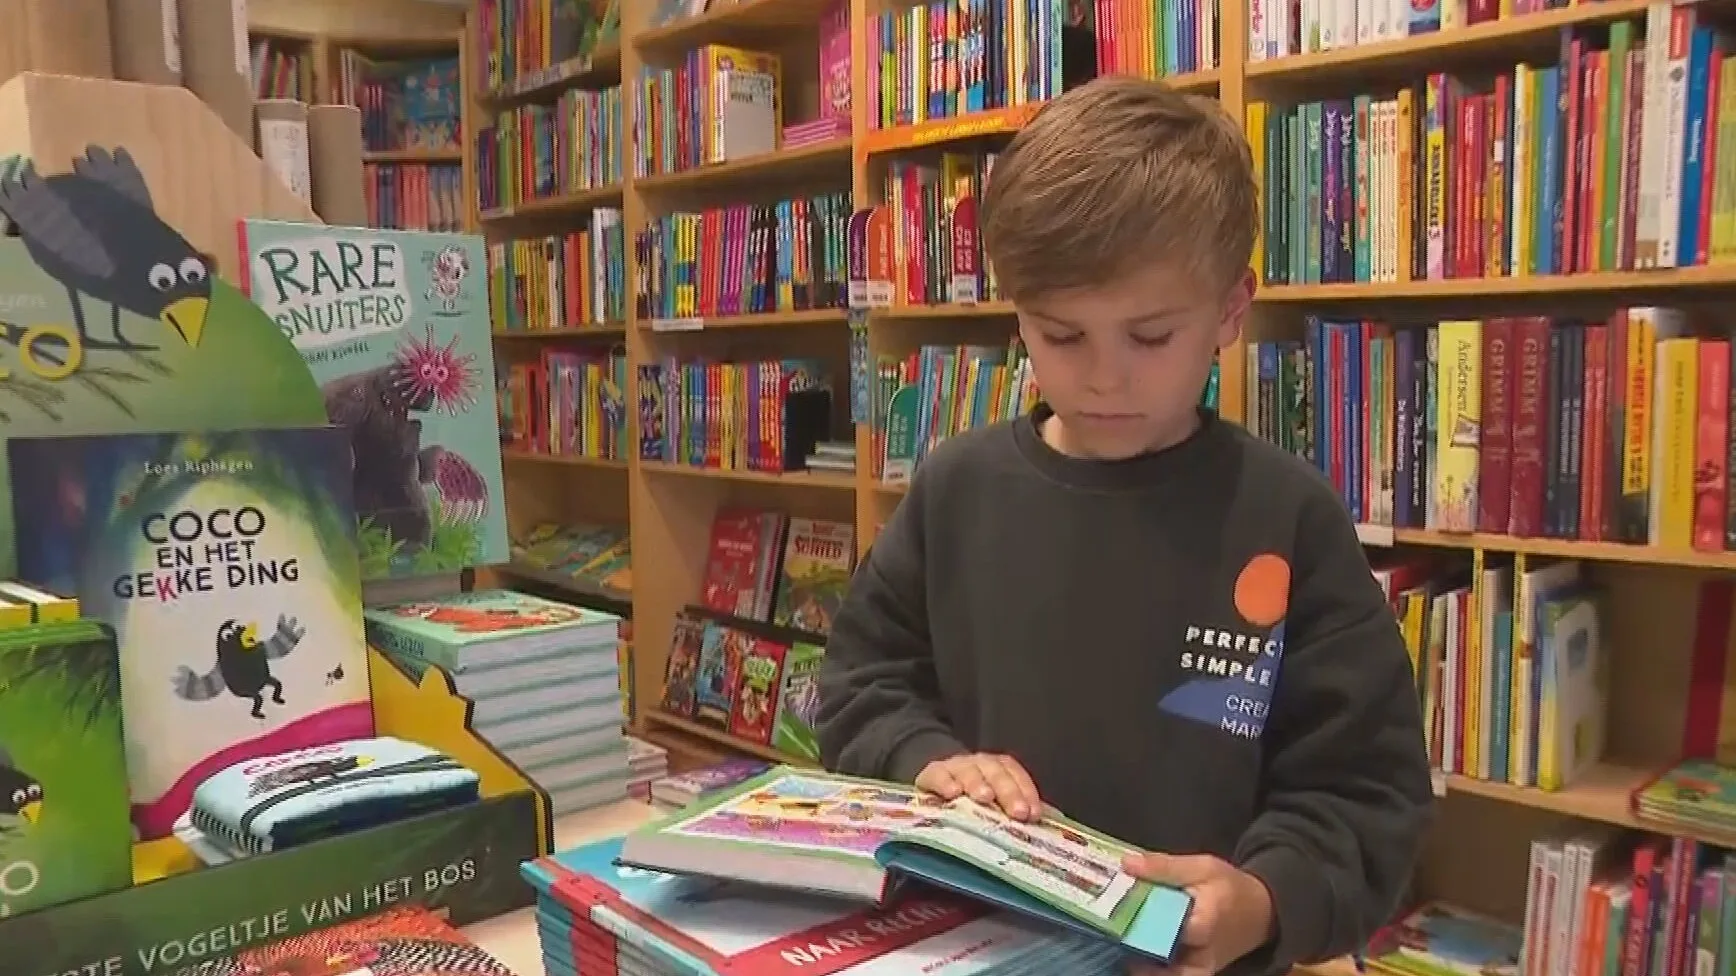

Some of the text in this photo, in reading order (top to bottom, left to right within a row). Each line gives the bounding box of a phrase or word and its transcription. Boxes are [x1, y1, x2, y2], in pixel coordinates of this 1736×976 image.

[260, 241, 396, 304] RARE
[275, 294, 406, 340] SNUITERS
[1457, 339, 1473, 416] Andersen
[144, 458, 254, 475] Loes Riphagen
[142, 506, 266, 543] COCO
[157, 540, 256, 569] EN HET
[113, 559, 298, 601] GEKKE DING
[1180, 652, 1272, 687] SIMPLE
[138, 908, 290, 972] VOGELTJE
[301, 893, 352, 925] VAN
[363, 876, 413, 909] HET
[424, 859, 476, 892] BOS
[779, 928, 877, 967] NAAR
